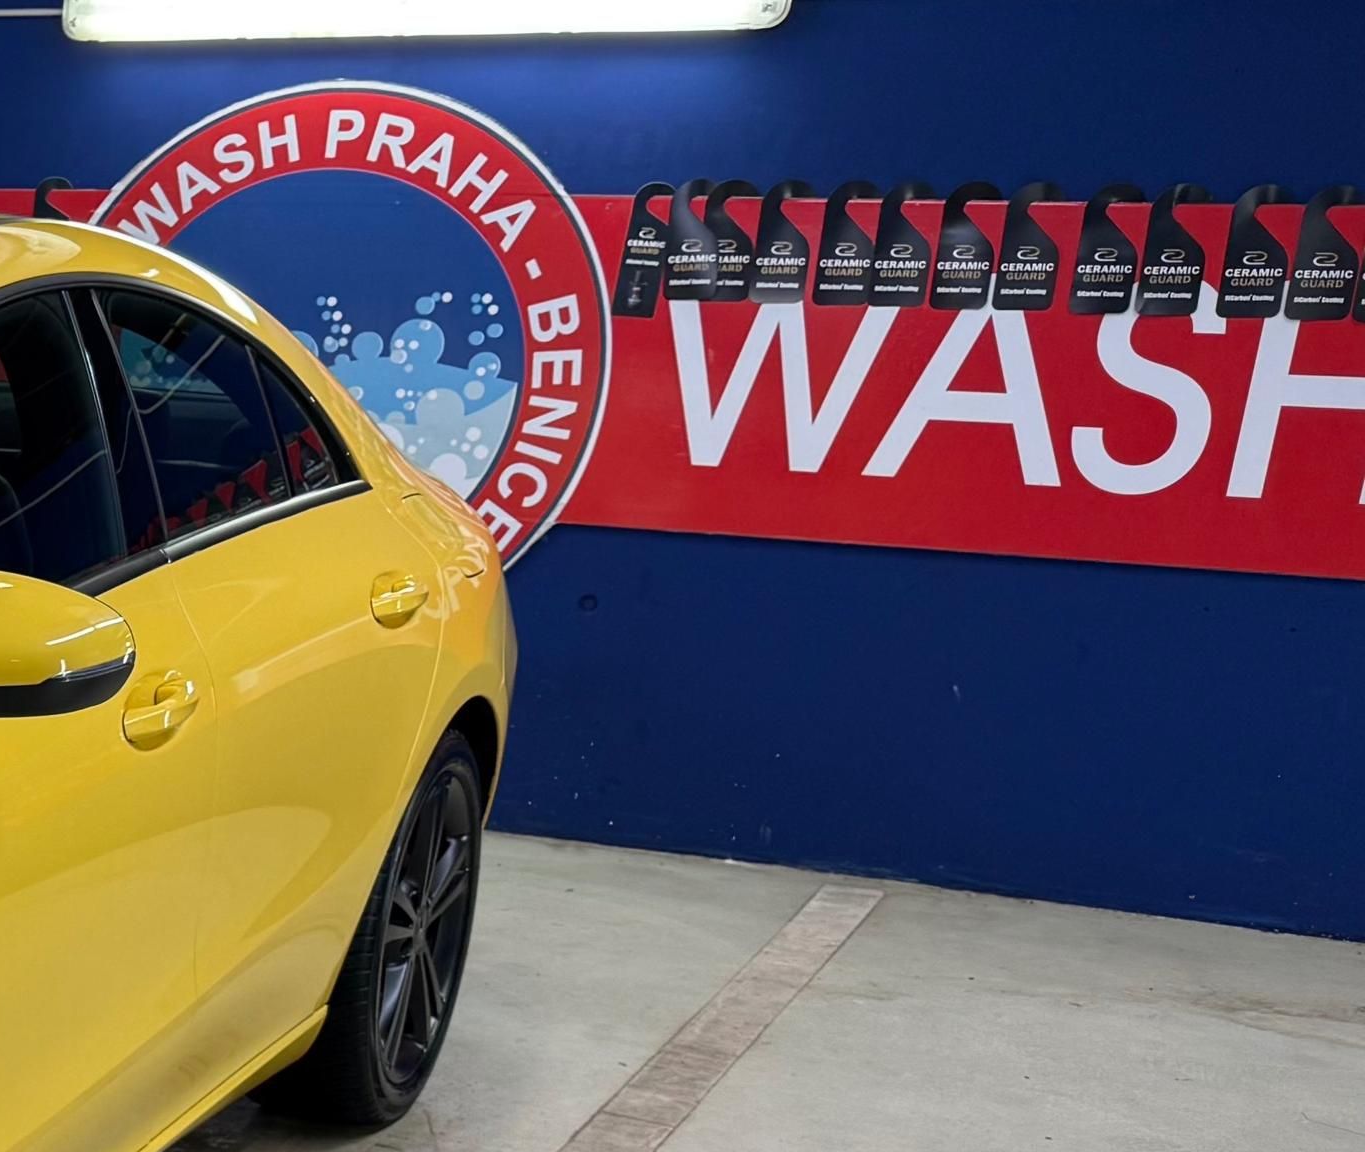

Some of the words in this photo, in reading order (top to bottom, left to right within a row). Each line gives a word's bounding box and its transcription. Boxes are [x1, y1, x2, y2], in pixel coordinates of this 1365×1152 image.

[668, 254, 717, 263] CERAMIC
[719, 255, 751, 264] AMIC
[756, 257, 806, 266] CERAMIC
[819, 259, 871, 268] CERAMIC
[874, 260, 927, 269] CERAMIC
[937, 261, 990, 270] CERAMIC
[1000, 262, 1055, 272] CERAMIC
[719, 264, 743, 273] ARD
[761, 266, 799, 275] GUARD
[824, 268, 863, 277] GUARD
[1077, 265, 1133, 274] CERAMIC
[1143, 266, 1201, 275] CERAMIC
[1224, 268, 1284, 277] CERAMIC
[879, 269, 919, 278] GUARD
[942, 270, 982, 279] GUARD
[1006, 271, 1046, 281] GUARD
[1294, 270, 1354, 279] CERAMIC
[1082, 274, 1124, 283] GUARD
[1149, 275, 1192, 284] GUARD
[1230, 278, 1274, 287] GUARD
[1300, 279, 1344, 288] GUARD
[117, 113, 302, 249] WASH
[324, 109, 539, 253] PRAHA
[476, 293, 583, 552] BENICE
